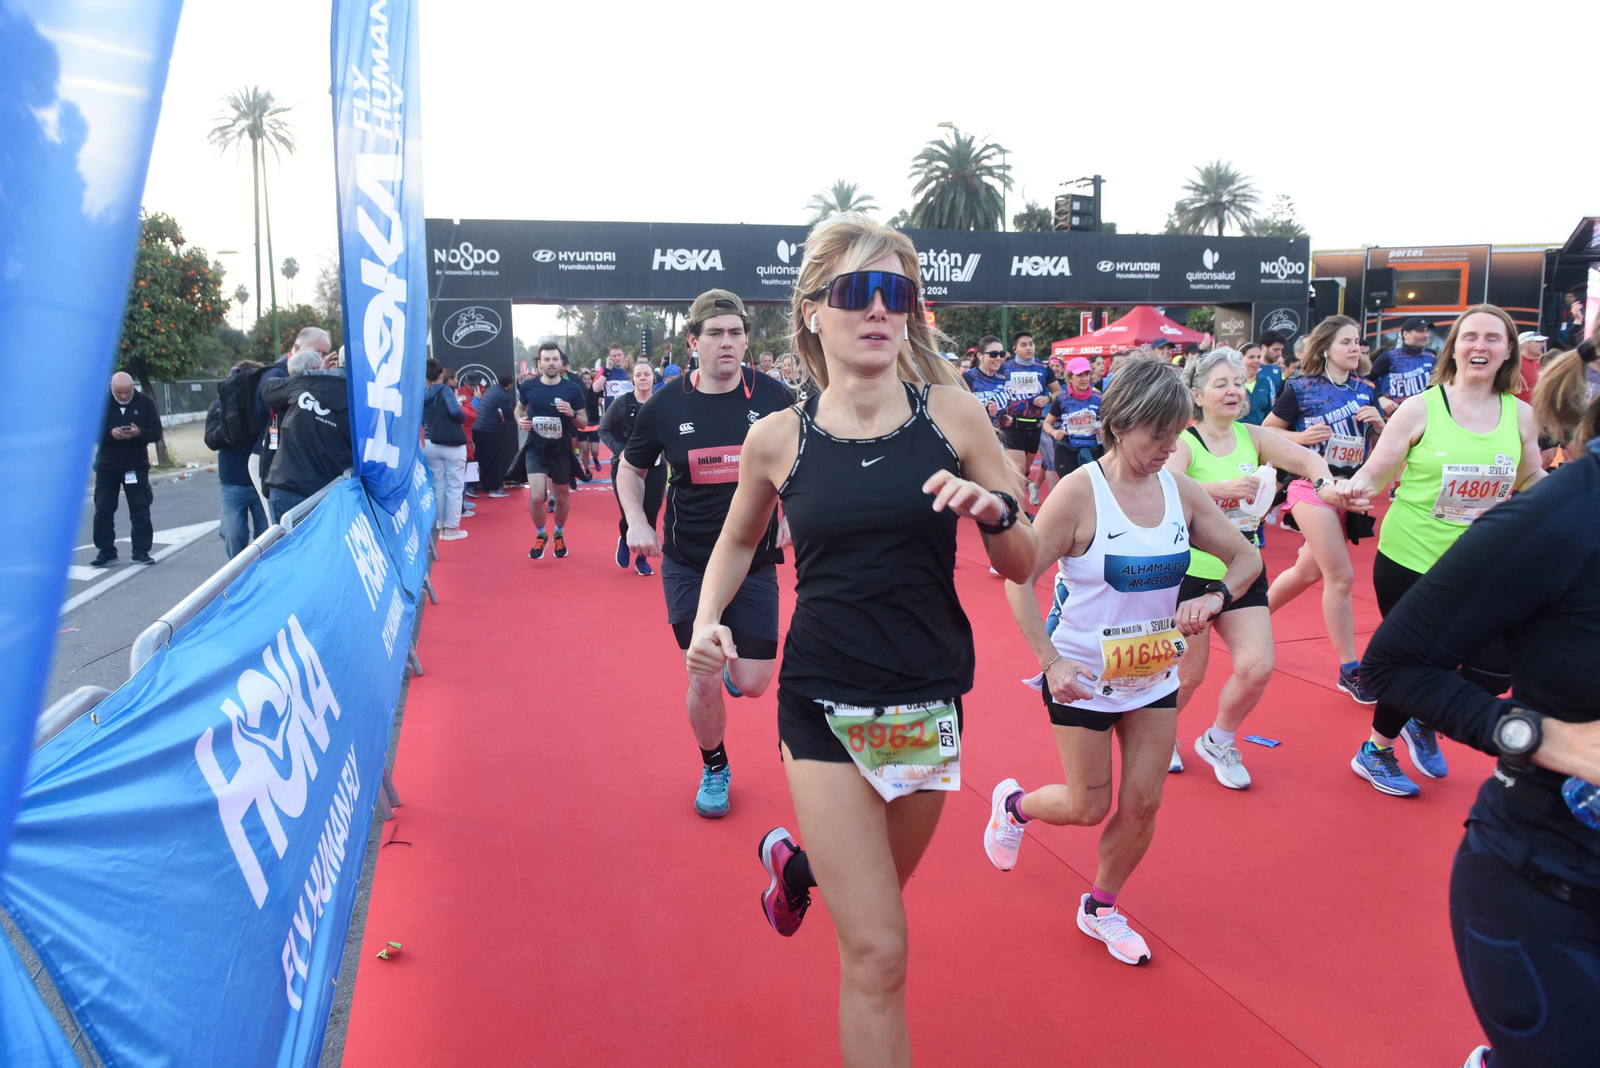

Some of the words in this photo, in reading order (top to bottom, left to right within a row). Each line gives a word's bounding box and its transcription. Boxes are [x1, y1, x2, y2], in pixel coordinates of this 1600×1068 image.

[352, 63, 372, 133] FLY
[558, 251, 616, 262] HYUNDAI
[652, 248, 723, 271] HOKA
[1011, 255, 1071, 276] HOKA
[558, 263, 595, 272] Hyundauto
[596, 263, 616, 271] Motor
[1116, 262, 1160, 271] HYUNDAI
[761, 278, 791, 286] Healthcare
[927, 286, 948, 295] 2024
[355, 153, 407, 469] HOKA
[1055, 347, 1074, 356] SPORT
[1325, 399, 1361, 425] MARATÓN
[535, 423, 558, 431] 13646
[698, 455, 722, 465] InLine
[1488, 466, 1509, 475] SEVILLA
[1448, 480, 1500, 498] 14801
[344, 510, 389, 613] HOKA
[1120, 562, 1171, 575] ALHAMA
[1173, 561, 1187, 571] DE
[1127, 574, 1175, 588] ARAGÓN
[1107, 628, 1121, 637] EDIO
[1121, 623, 1143, 635] MARATÓN
[1151, 619, 1169, 632] SEVILLA
[1112, 639, 1176, 669] 11648
[847, 720, 929, 753] 8962
[194, 613, 341, 910] HOKA
[281, 894, 313, 1012] FLY
[304, 781, 355, 935] HUMAN
[340, 743, 361, 815] FLY
